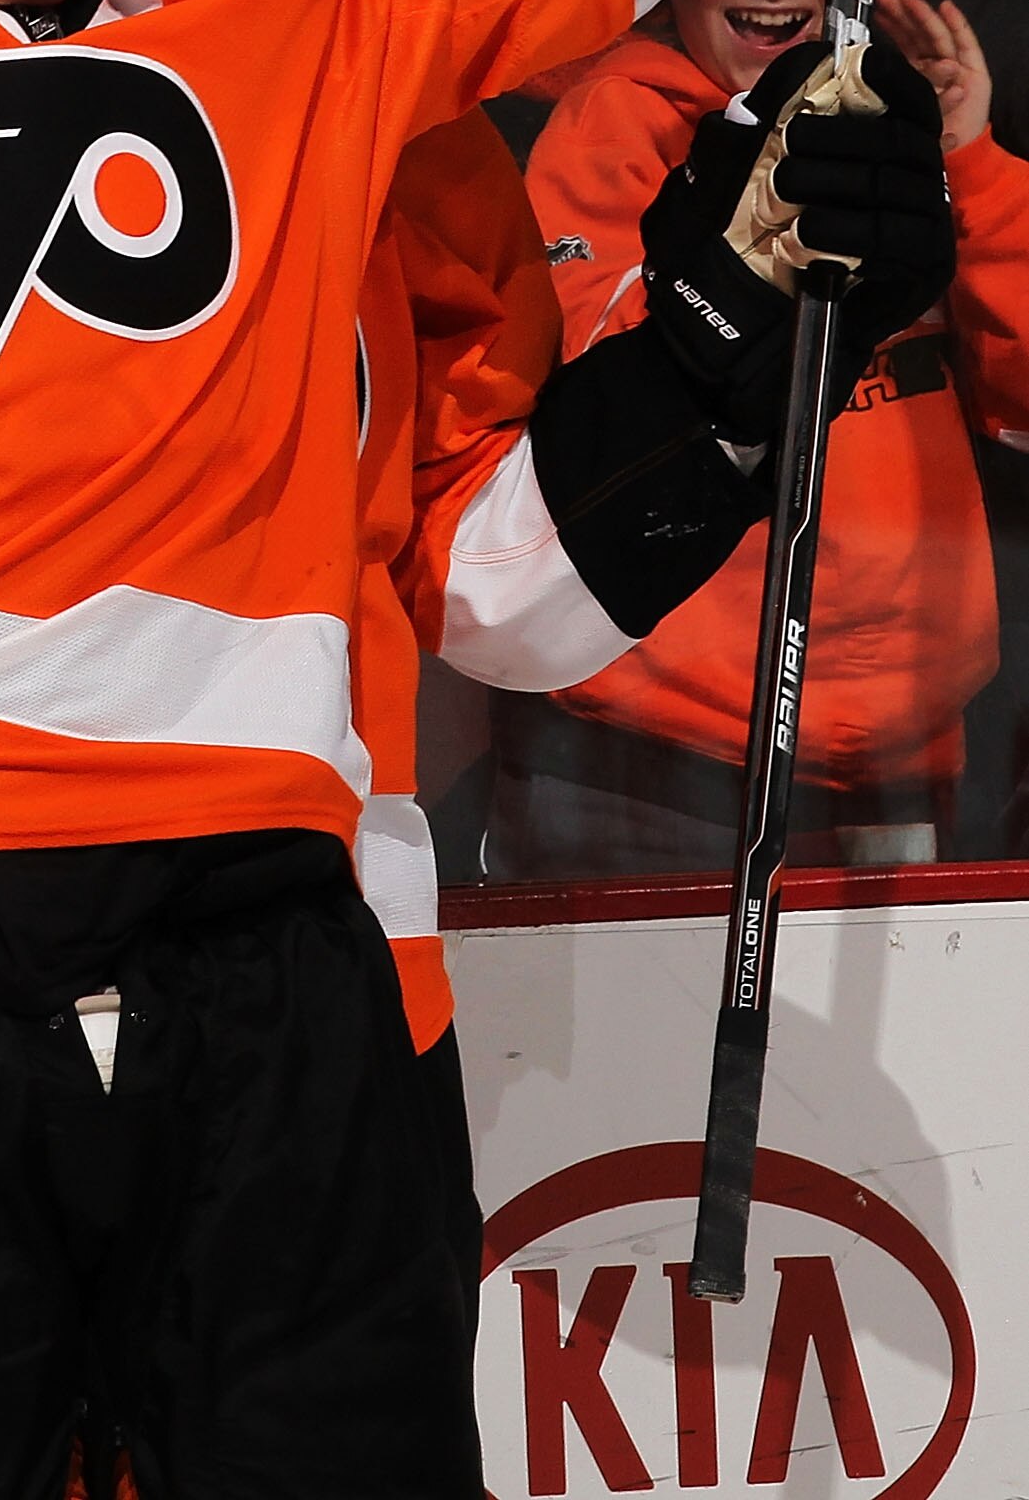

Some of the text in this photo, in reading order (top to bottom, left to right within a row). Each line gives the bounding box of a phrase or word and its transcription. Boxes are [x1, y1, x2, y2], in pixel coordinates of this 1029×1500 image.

[673, 278, 741, 340] BAUER
[738, 898, 762, 1009] TOTALONE
[512, 1255, 886, 1497] KIA
